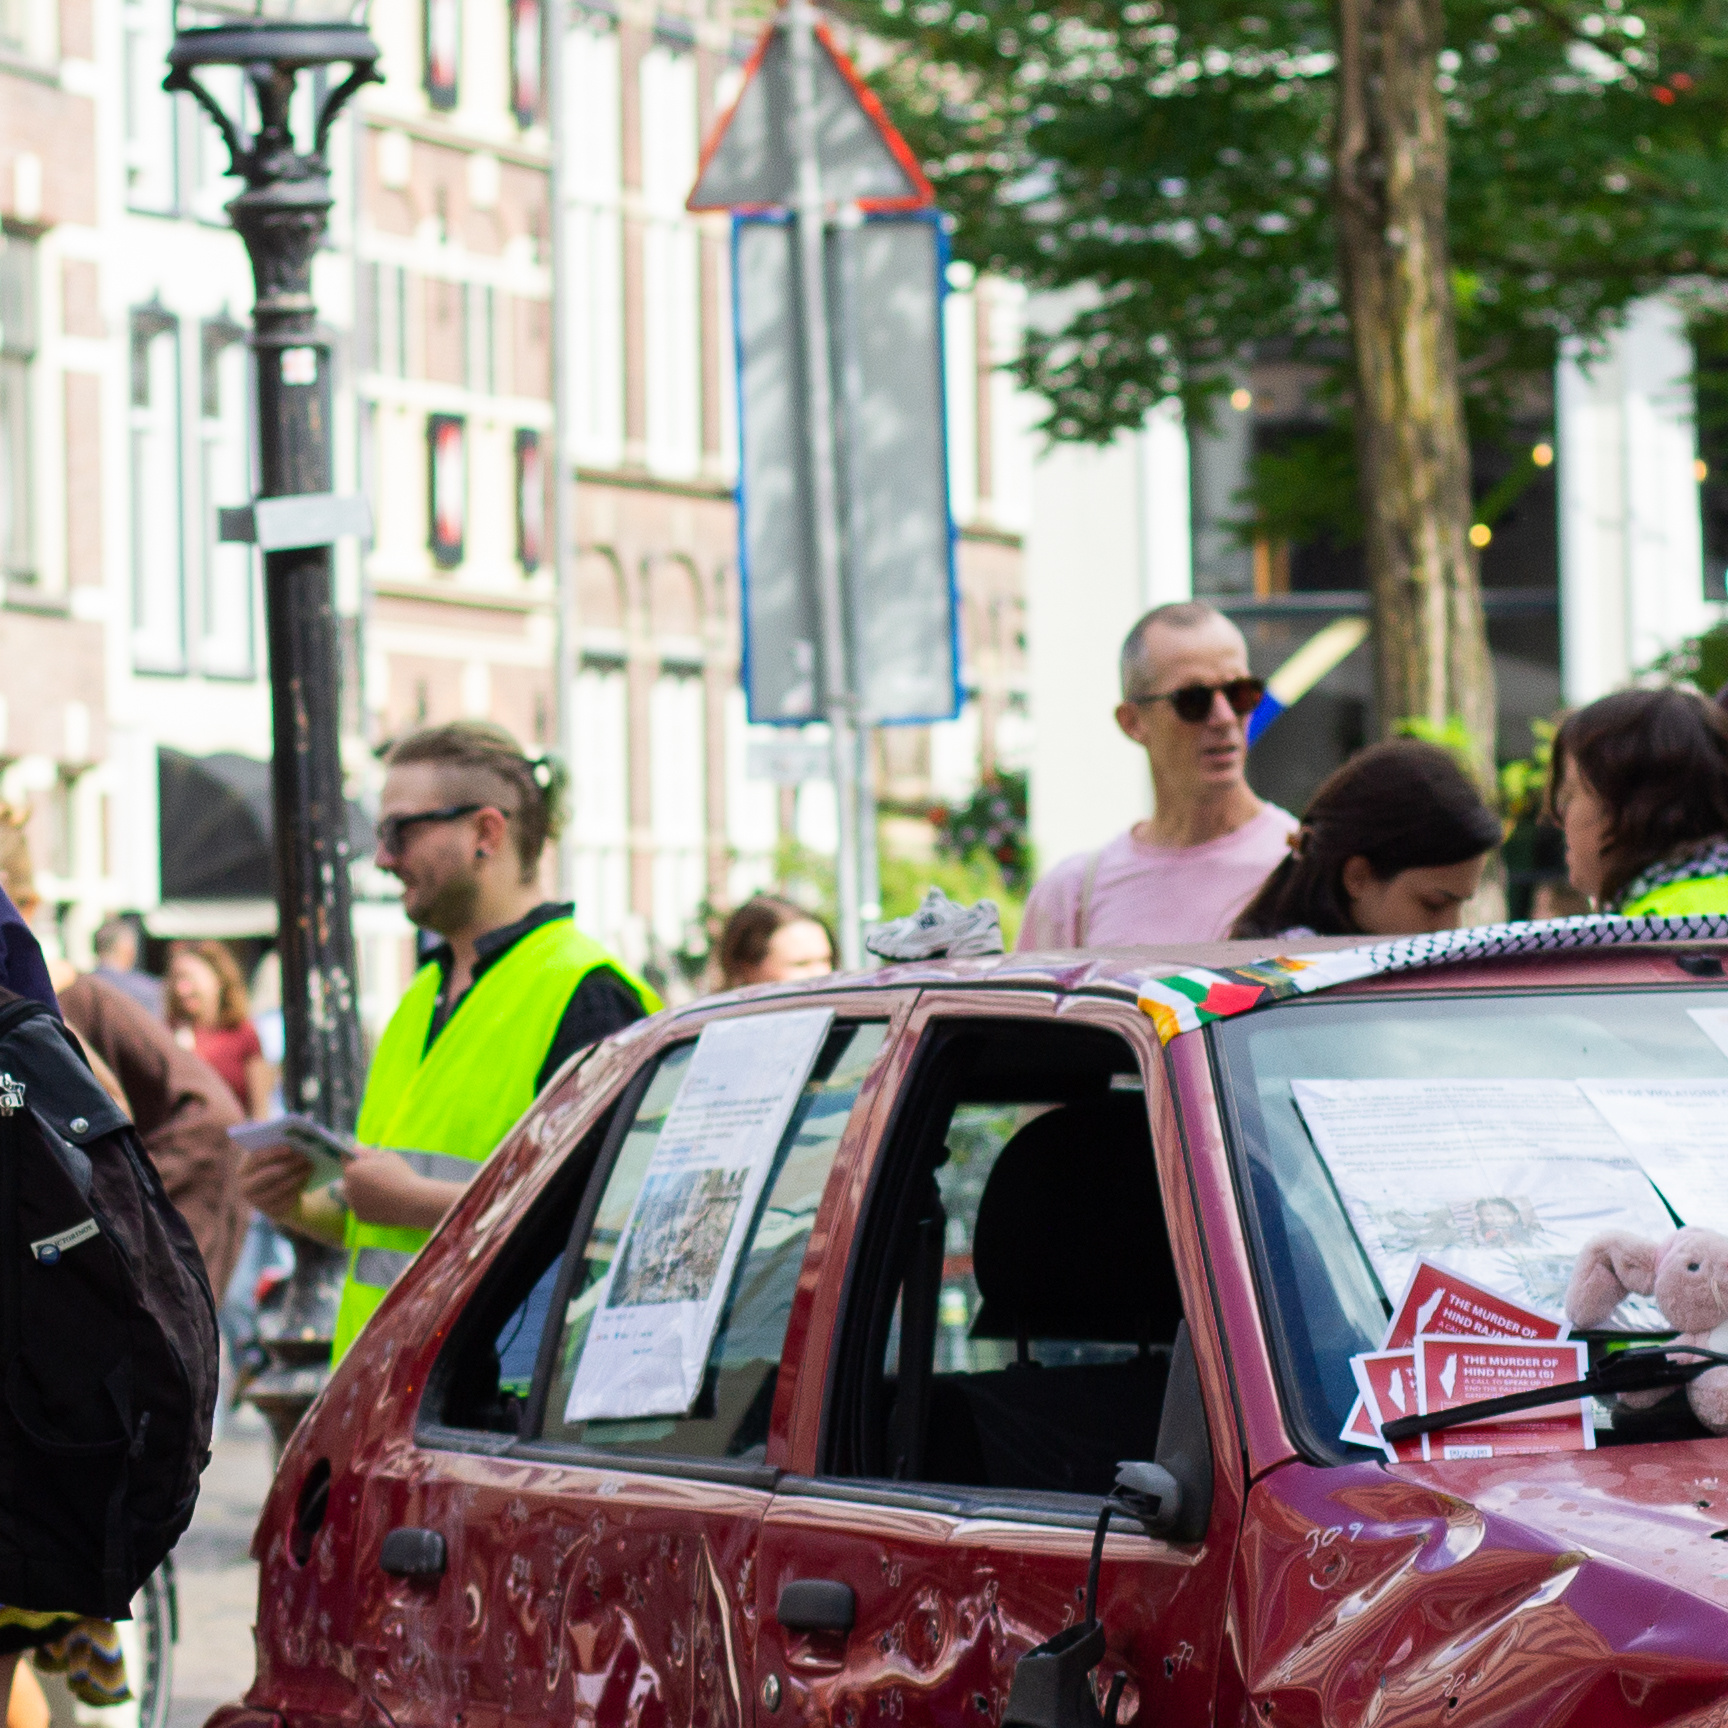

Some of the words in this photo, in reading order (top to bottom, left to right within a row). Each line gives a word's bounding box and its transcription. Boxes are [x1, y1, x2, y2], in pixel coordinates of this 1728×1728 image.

[1442, 1307, 1473, 1329] HIND
[1449, 1293, 1472, 1312] THE
[1472, 1304, 1521, 1333] MURDER
[1521, 1325, 1538, 1339] OF
[1463, 1355, 1486, 1366] THE
[1488, 1356, 1540, 1367] MURDER
[1542, 1358, 1559, 1368] OF
[1464, 1367, 1495, 1377] HIND
[1497, 1368, 1537, 1379] RAJAB
